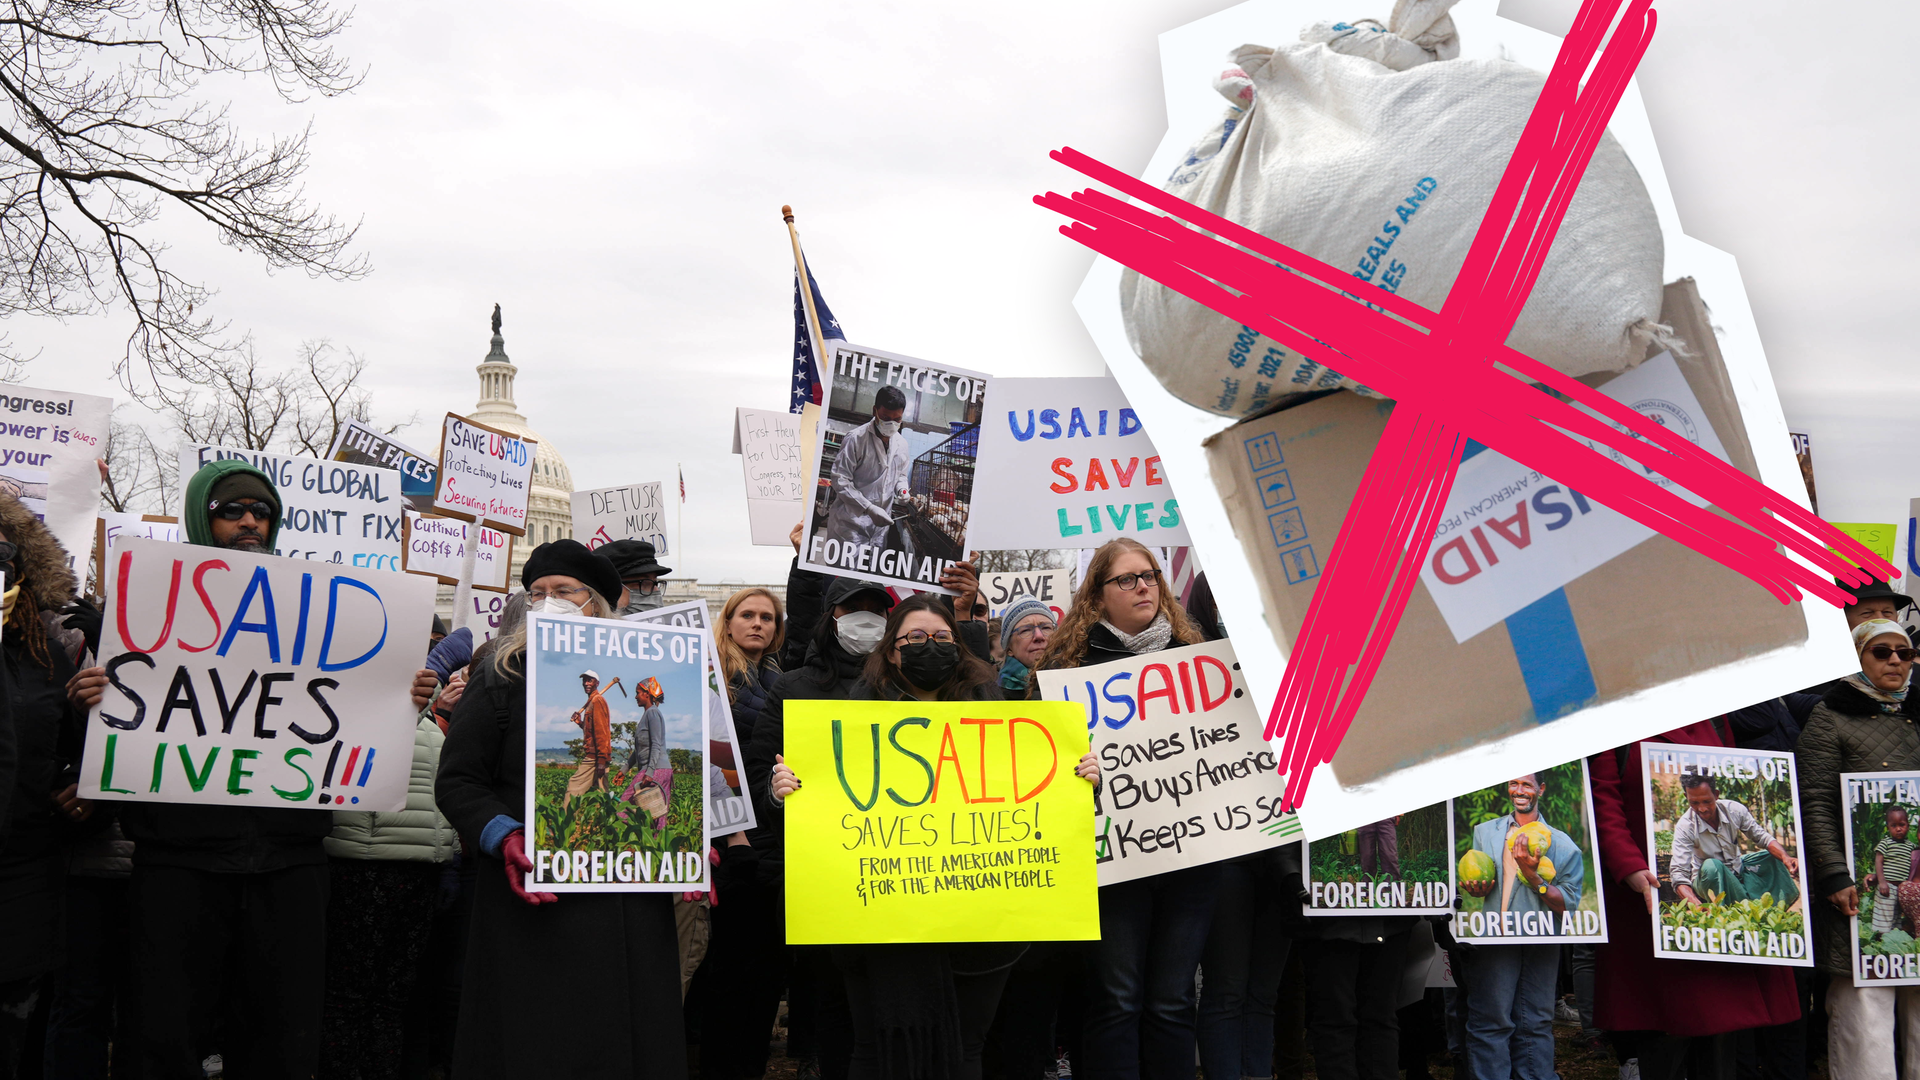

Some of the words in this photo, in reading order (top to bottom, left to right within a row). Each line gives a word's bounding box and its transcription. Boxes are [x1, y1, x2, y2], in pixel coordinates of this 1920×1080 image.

[1395, 176, 1438, 226] AND
[837, 350, 881, 383] THE
[885, 358, 950, 398] FACES
[955, 376, 985, 404] OF
[1257, 346, 1286, 379] 2021
[53, 425, 70, 443] is
[73, 431, 98, 446] was
[775, 418, 795, 448] they
[1008, 407, 1143, 442] USAID
[0, 449, 52, 467] your
[346, 426, 383, 459] THE
[381, 445, 436, 483] FACES
[451, 421, 486, 455] SAVE
[489, 434, 527, 467] USAID
[746, 444, 764, 463] for
[1791, 434, 1809, 456] OF
[302, 463, 389, 503] GLOBAL
[445, 450, 497, 488] Protecting
[501, 471, 523, 489] Lives
[750, 466, 786, 485] Congress,
[1049, 455, 1163, 495] SAVE
[444, 477, 487, 517] Securing
[490, 498, 524, 519] Futures
[590, 484, 663, 516] DETUSK
[757, 484, 784, 497] YOUR
[1463, 476, 1528, 521] AMERICAN
[280, 506, 347, 536] WON'T
[362, 513, 401, 543] FIX
[626, 512, 660, 535] MUSK
[1057, 499, 1180, 538] LIVES
[462, 525, 504, 548] AID
[809, 535, 913, 578] FOREIGN
[990, 575, 1054, 605] SAVE
[117, 550, 388, 672] USAID
[671, 609, 702, 628] OF
[537, 621, 587, 655] THE
[594, 627, 664, 662] FACES
[670, 635, 699, 664] OF
[99, 652, 340, 744] SAVES
[1064, 655, 1244, 730] USAID:
[1190, 722, 1240, 751] lives
[100, 740, 376, 804] LIVES!!!
[831, 716, 1057, 812] USAID
[1650, 751, 1692, 776] THE
[1697, 754, 1757, 780] FACES
[1762, 758, 1788, 782] OF
[1109, 770, 1194, 810] Buys
[1850, 779, 1892, 804] THE
[709, 796, 745, 828] AID
[841, 813, 938, 850] SAVES
[951, 802, 1042, 846] LIVES!
[1115, 815, 1205, 859] Keeps
[536, 850, 651, 882] FOREIGN
[659, 851, 701, 882] AID
[859, 857, 902, 876] FROM
[905, 856, 936, 874] THE
[941, 850, 1015, 873] AMERICAN
[1018, 847, 1060, 865] PEOPLE
[857, 878, 867, 907] &
[870, 879, 896, 899] FOR
[900, 877, 930, 895] THE
[934, 872, 1002, 894] AMERICAN
[1004, 869, 1056, 890] PEOPLE
[1312, 881, 1406, 908] FOREIGN
[1412, 882, 1448, 908] AID
[1457, 910, 1555, 937] FOREIGN
[1560, 910, 1600, 936] AID
[1662, 925, 1760, 956] FOREIGN
[1766, 932, 1805, 959] AID
